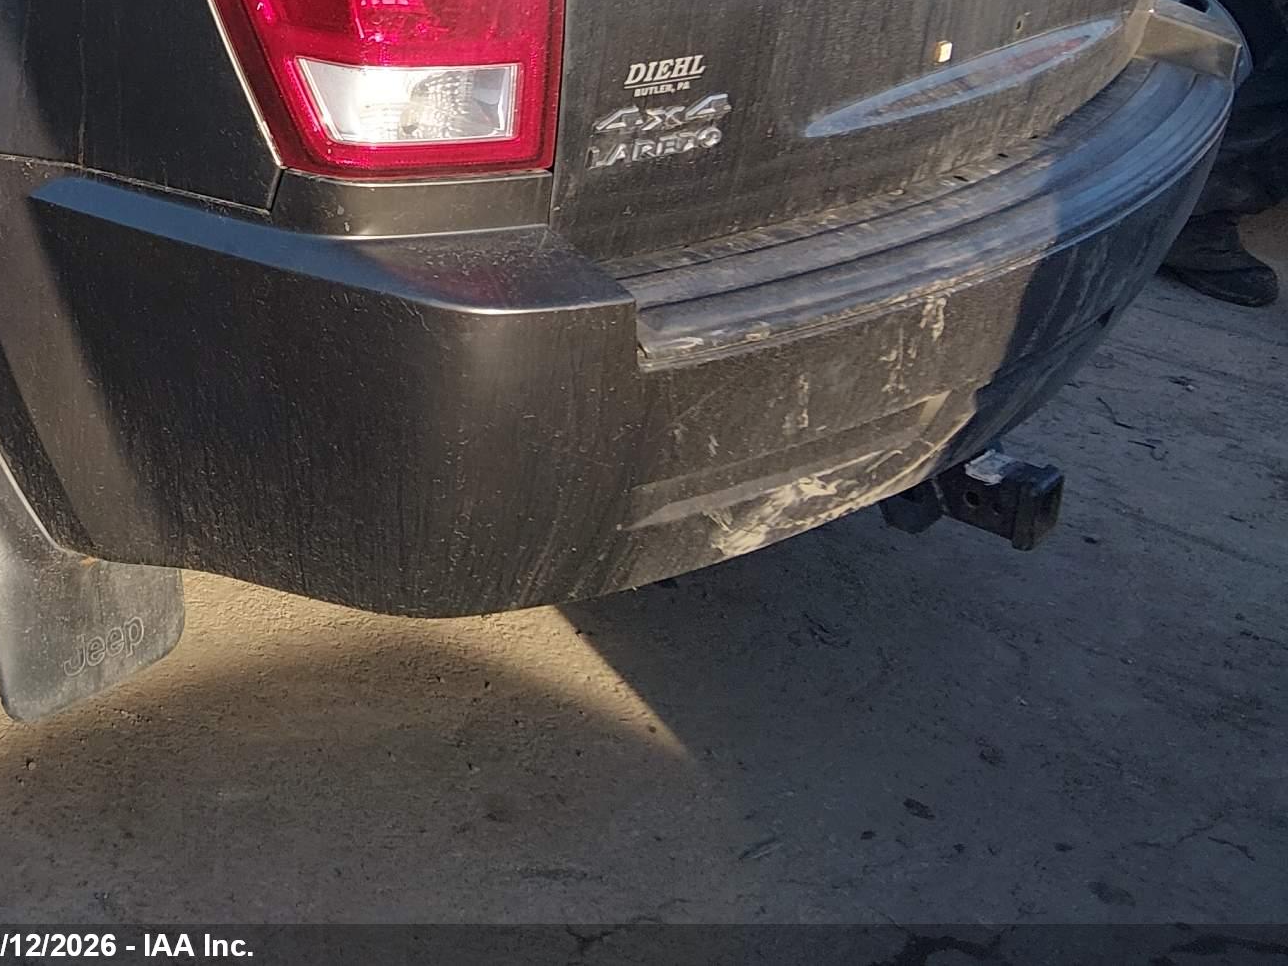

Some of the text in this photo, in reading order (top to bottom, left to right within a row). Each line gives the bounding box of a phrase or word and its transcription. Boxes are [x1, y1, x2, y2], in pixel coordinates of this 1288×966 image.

[623, 54, 706, 85] DIEHL
[676, 80, 691, 91] PA
[585, 124, 723, 171] LAREDO
[63, 616, 145, 678] Jeep
